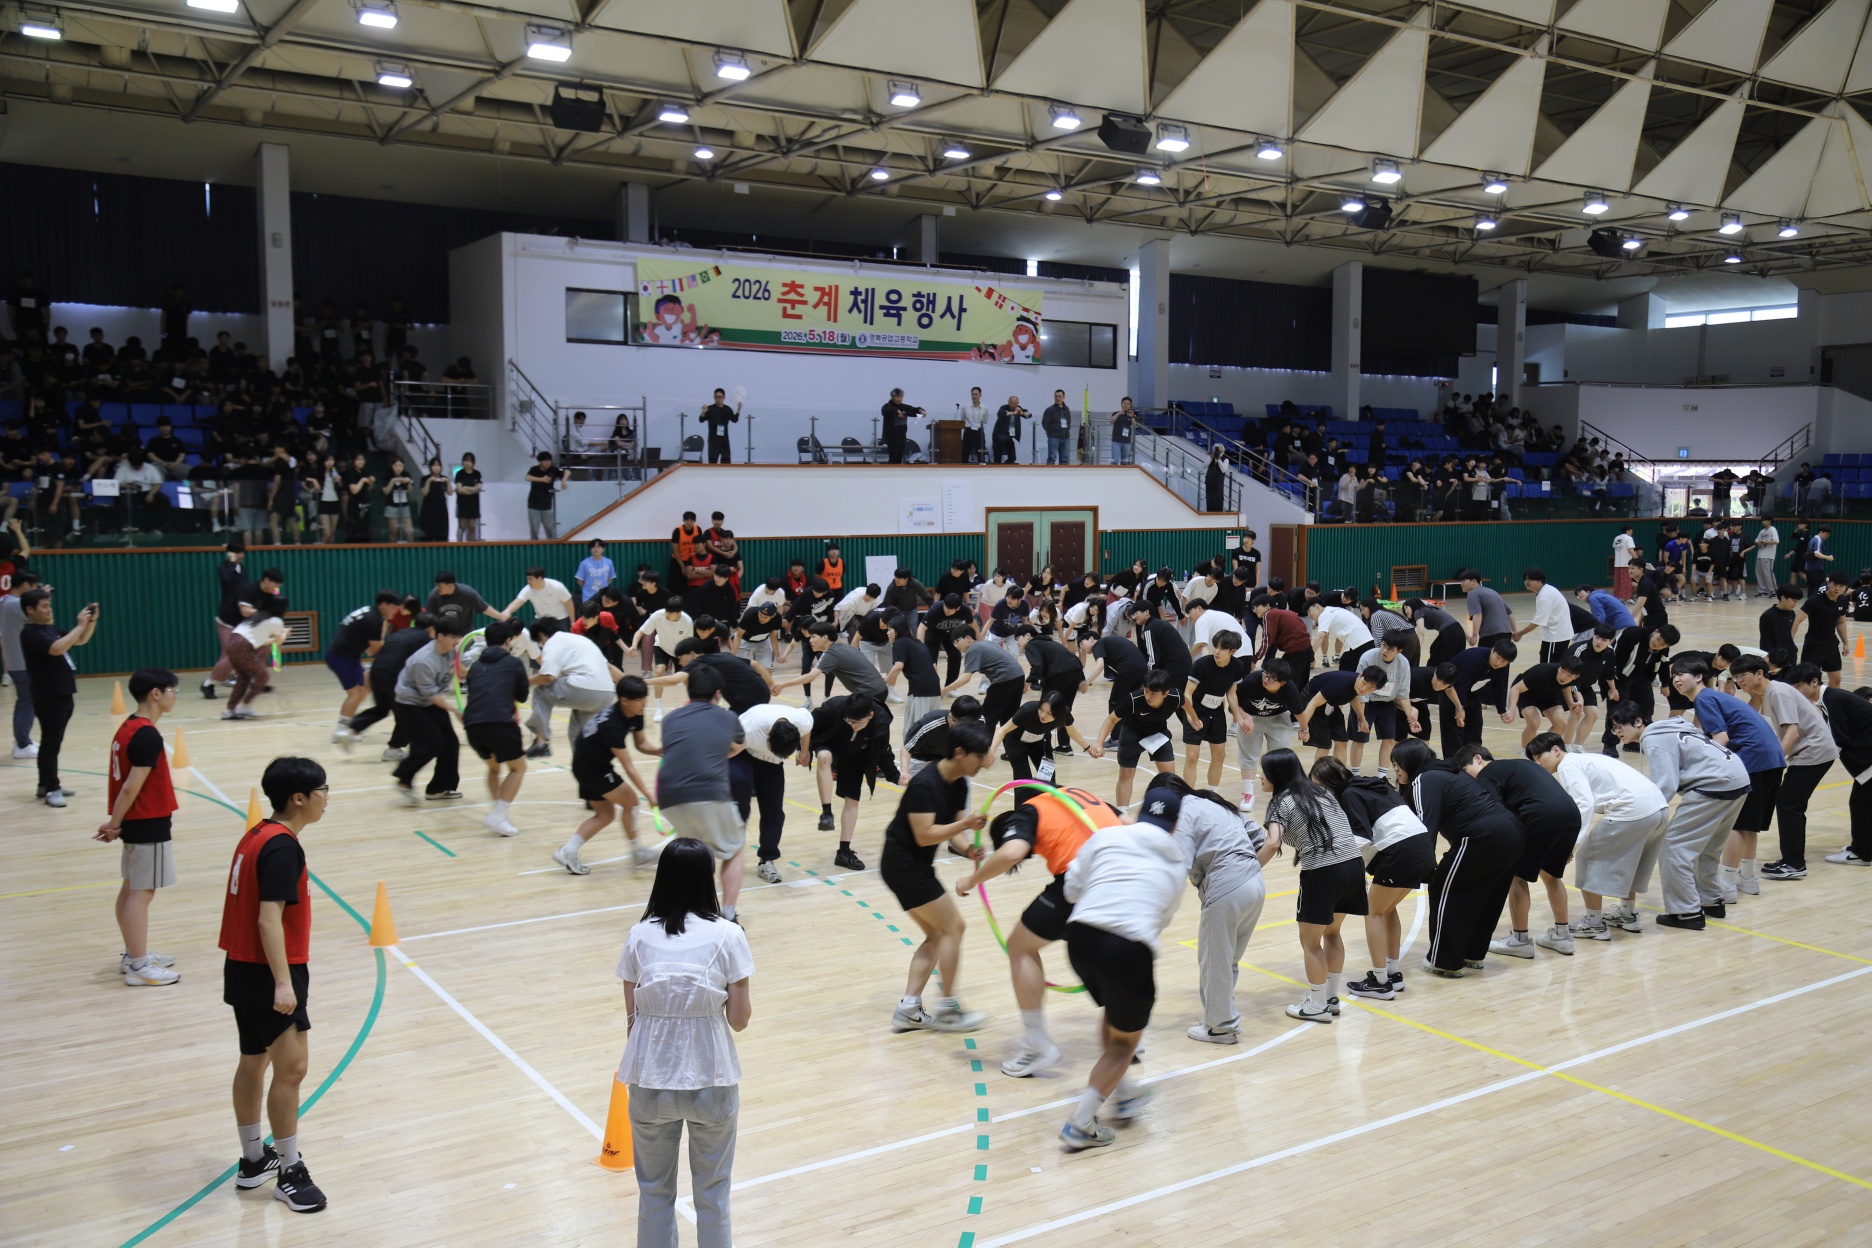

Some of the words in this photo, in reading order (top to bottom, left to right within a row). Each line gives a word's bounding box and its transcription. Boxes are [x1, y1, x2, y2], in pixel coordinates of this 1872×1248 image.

[731, 278, 771, 301] 2026
[777, 280, 839, 323] 춘계
[847, 287, 967, 331] 체육행사
[782, 331, 805, 342] 2026.
[869, 334, 918, 344] 경북공업고등학교
